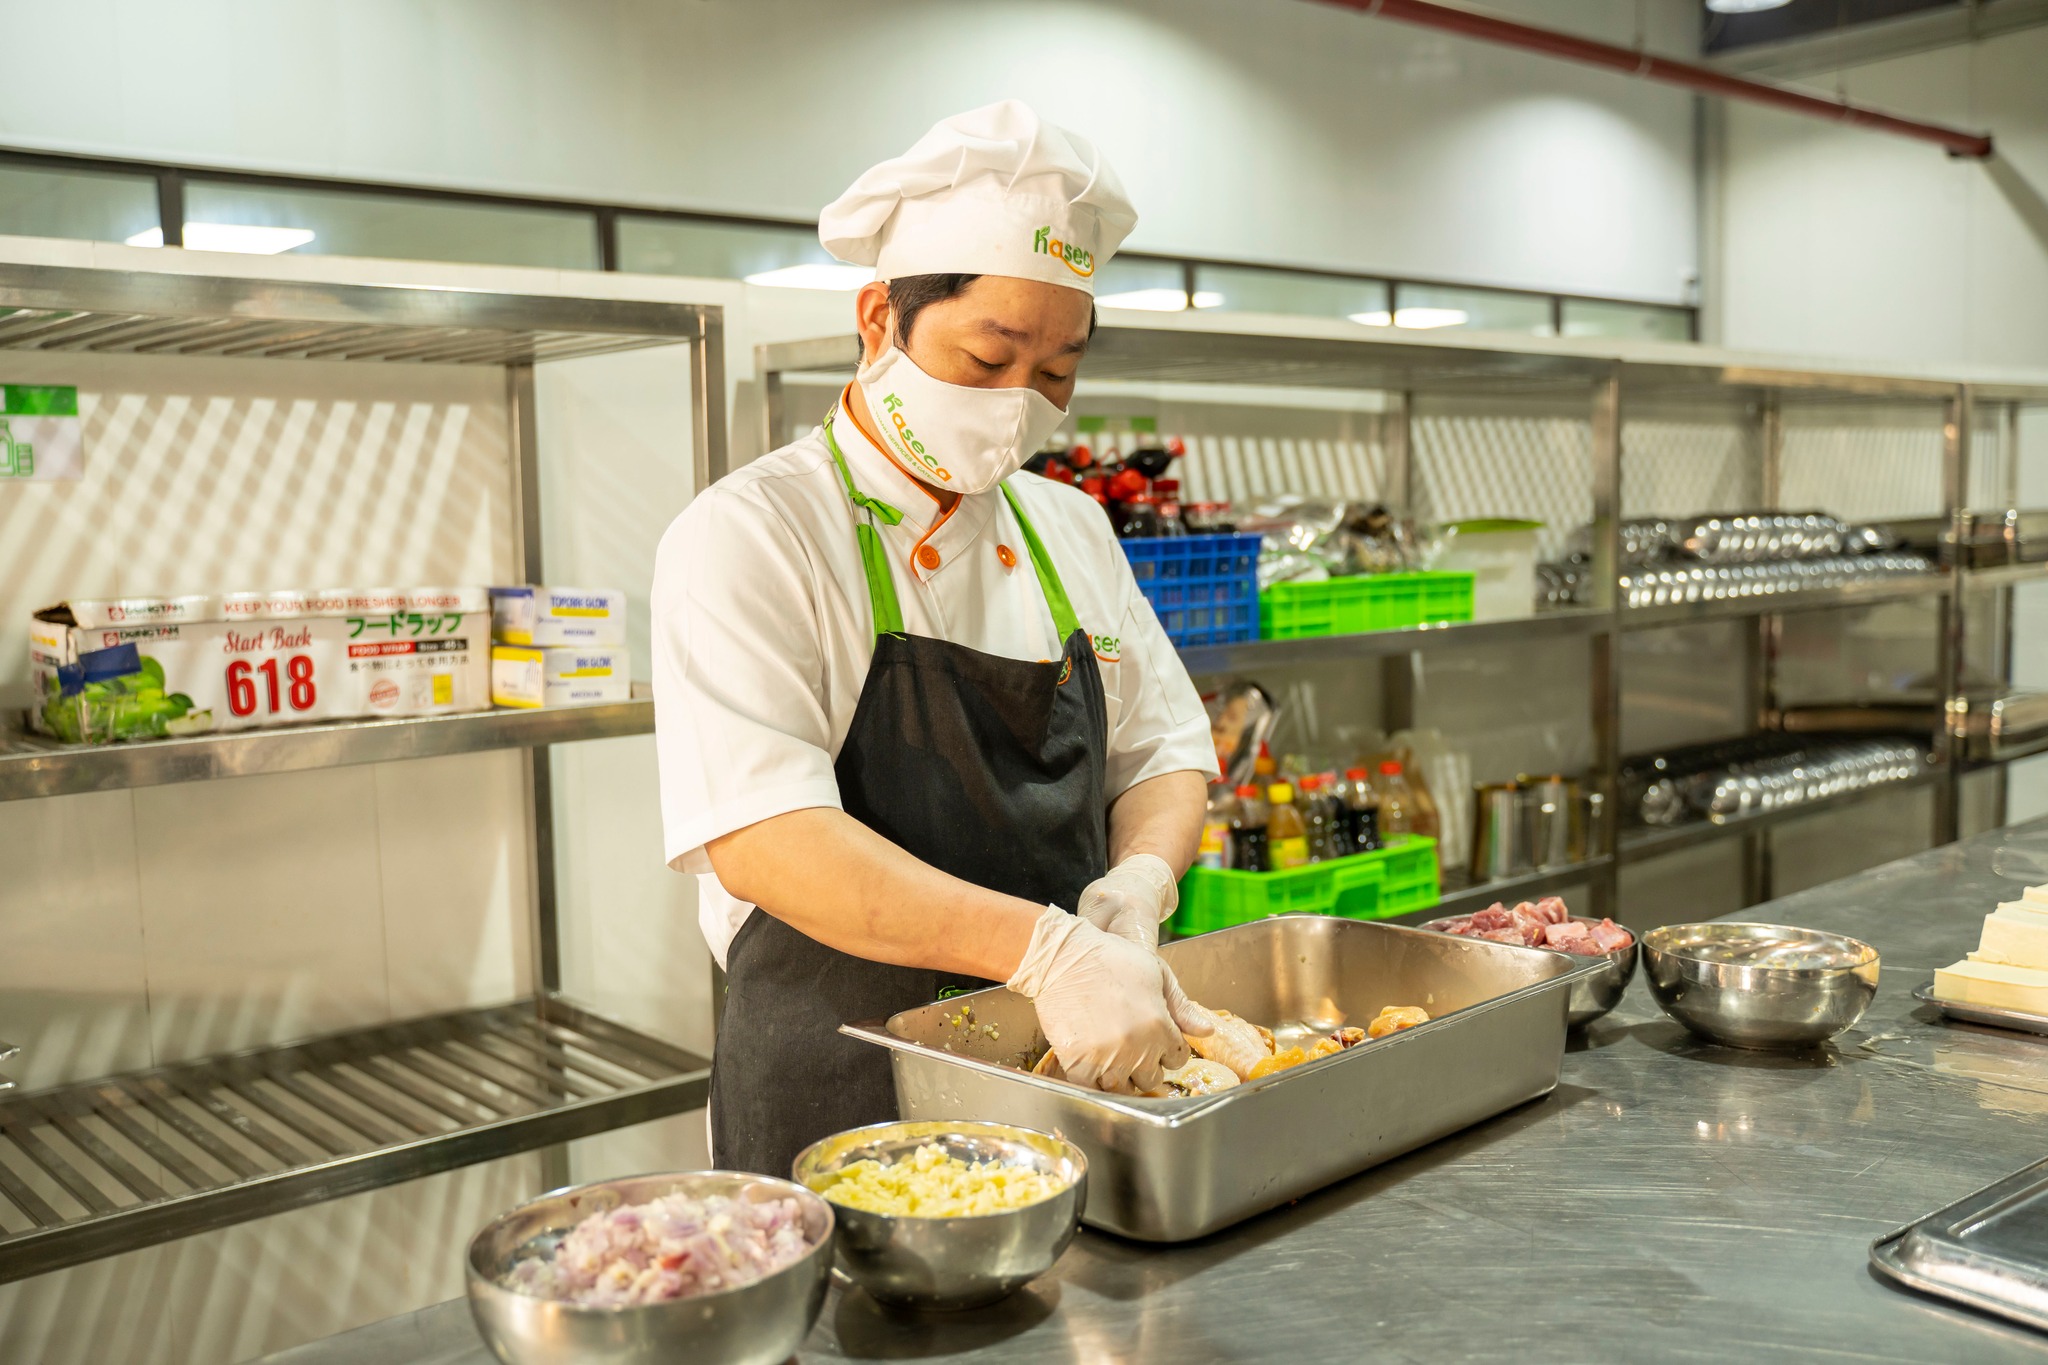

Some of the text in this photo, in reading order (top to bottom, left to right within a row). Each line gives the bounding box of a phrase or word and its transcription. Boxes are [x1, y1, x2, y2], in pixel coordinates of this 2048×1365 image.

[224, 594, 461, 614] KEEP YOUR FOOD FRESHER LONGER
[223, 625, 312, 654] Start Back
[225, 654, 317, 717] 618
